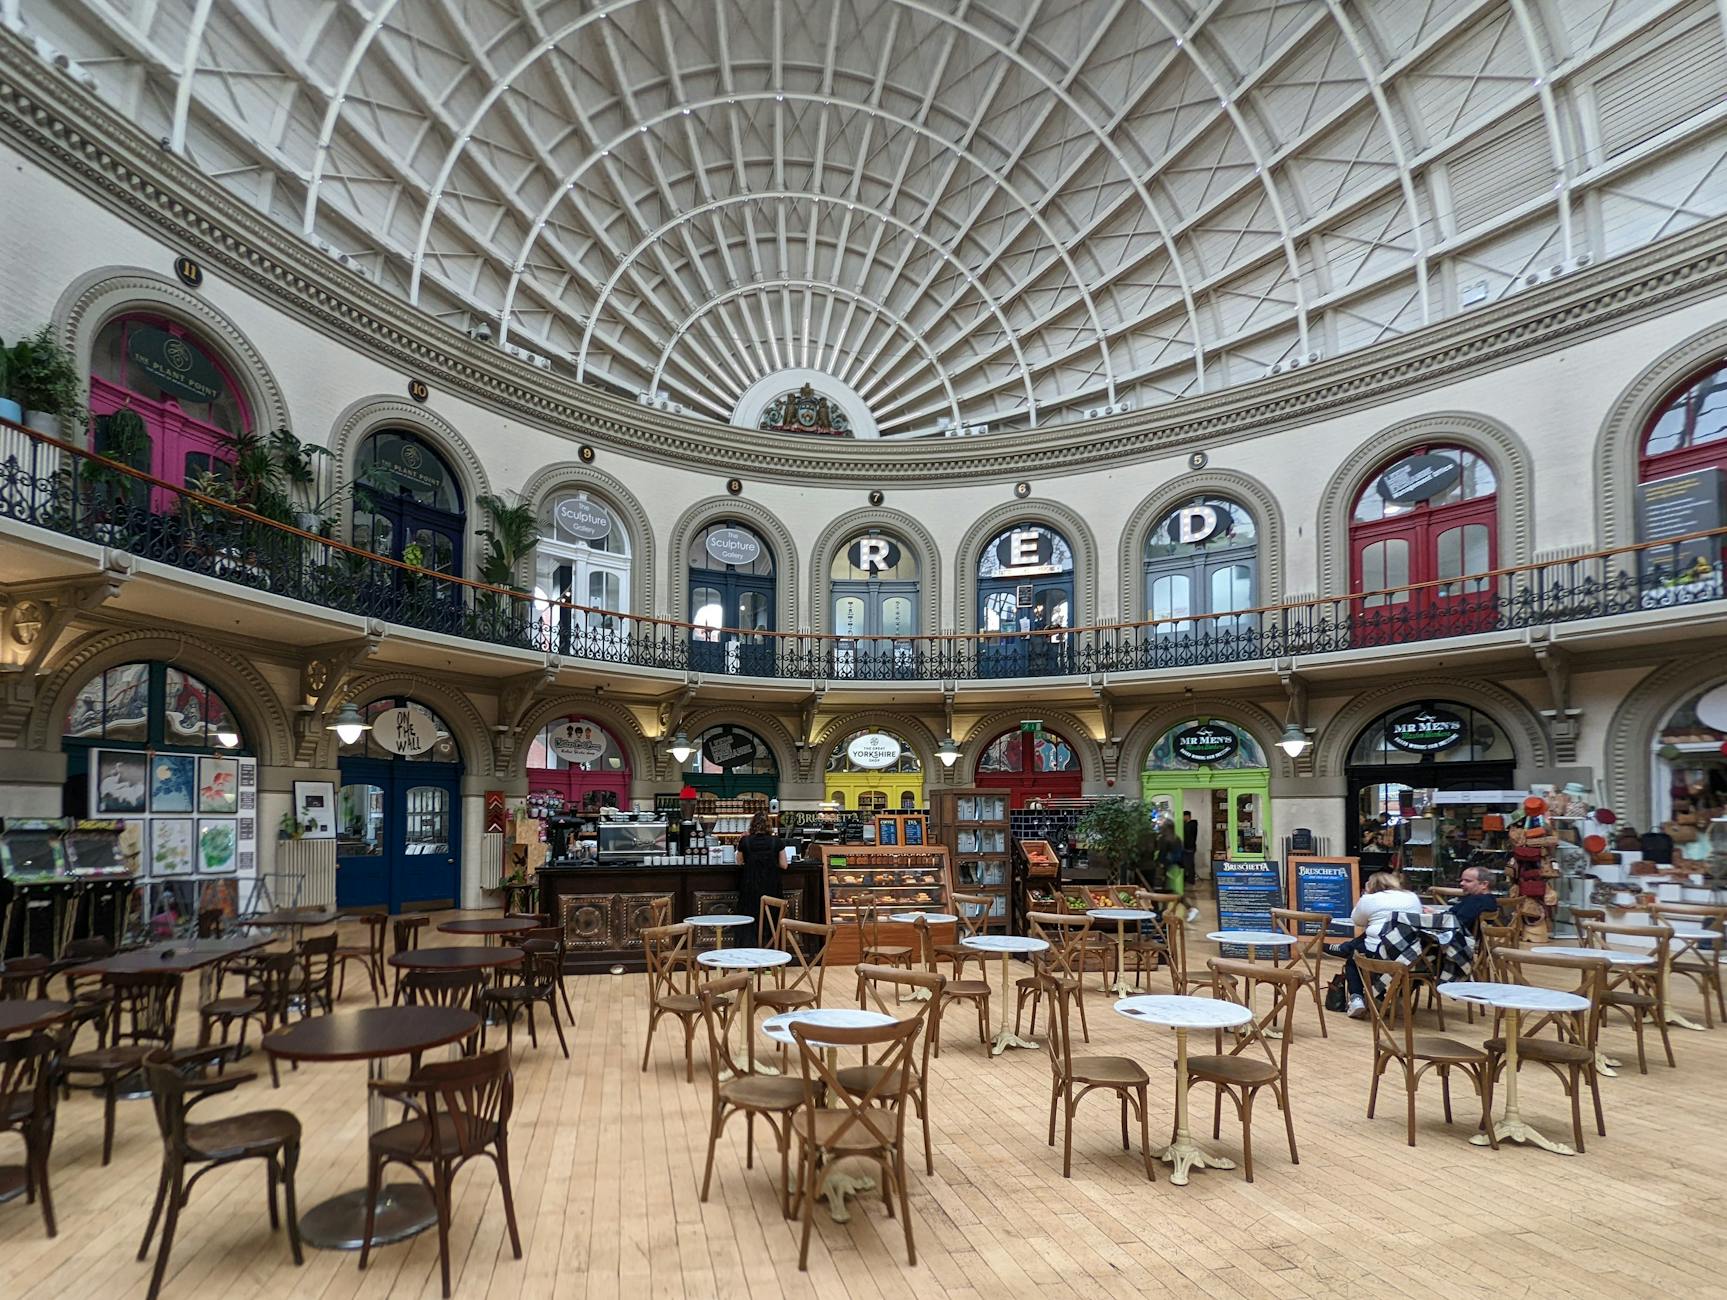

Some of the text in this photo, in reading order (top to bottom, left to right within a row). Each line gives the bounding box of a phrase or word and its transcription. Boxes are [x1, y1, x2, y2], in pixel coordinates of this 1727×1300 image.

[184, 260, 196, 280] 11
[152, 362, 186, 382] PLANT
[188, 379, 217, 398] POINT
[413, 382, 427, 397] 10
[583, 448, 592, 459] 9
[1194, 454, 1203, 465] 5
[731, 481, 740, 491] 8
[1018, 483, 1027, 494] 6
[873, 492, 881, 502] 7
[561, 506, 607, 527] Sculpture
[1180, 506, 1217, 544] D
[711, 537, 756, 551] Sculpture
[1010, 532, 1040, 565] E
[860, 538, 890, 571] R
[397, 710, 410, 725] ON
[396, 723, 416, 739] THE
[1393, 724, 1417, 734] MR
[396, 736, 422, 753] WALL
[1180, 736, 1198, 746] MR
[853, 751, 896, 759] YORKSHIRE
